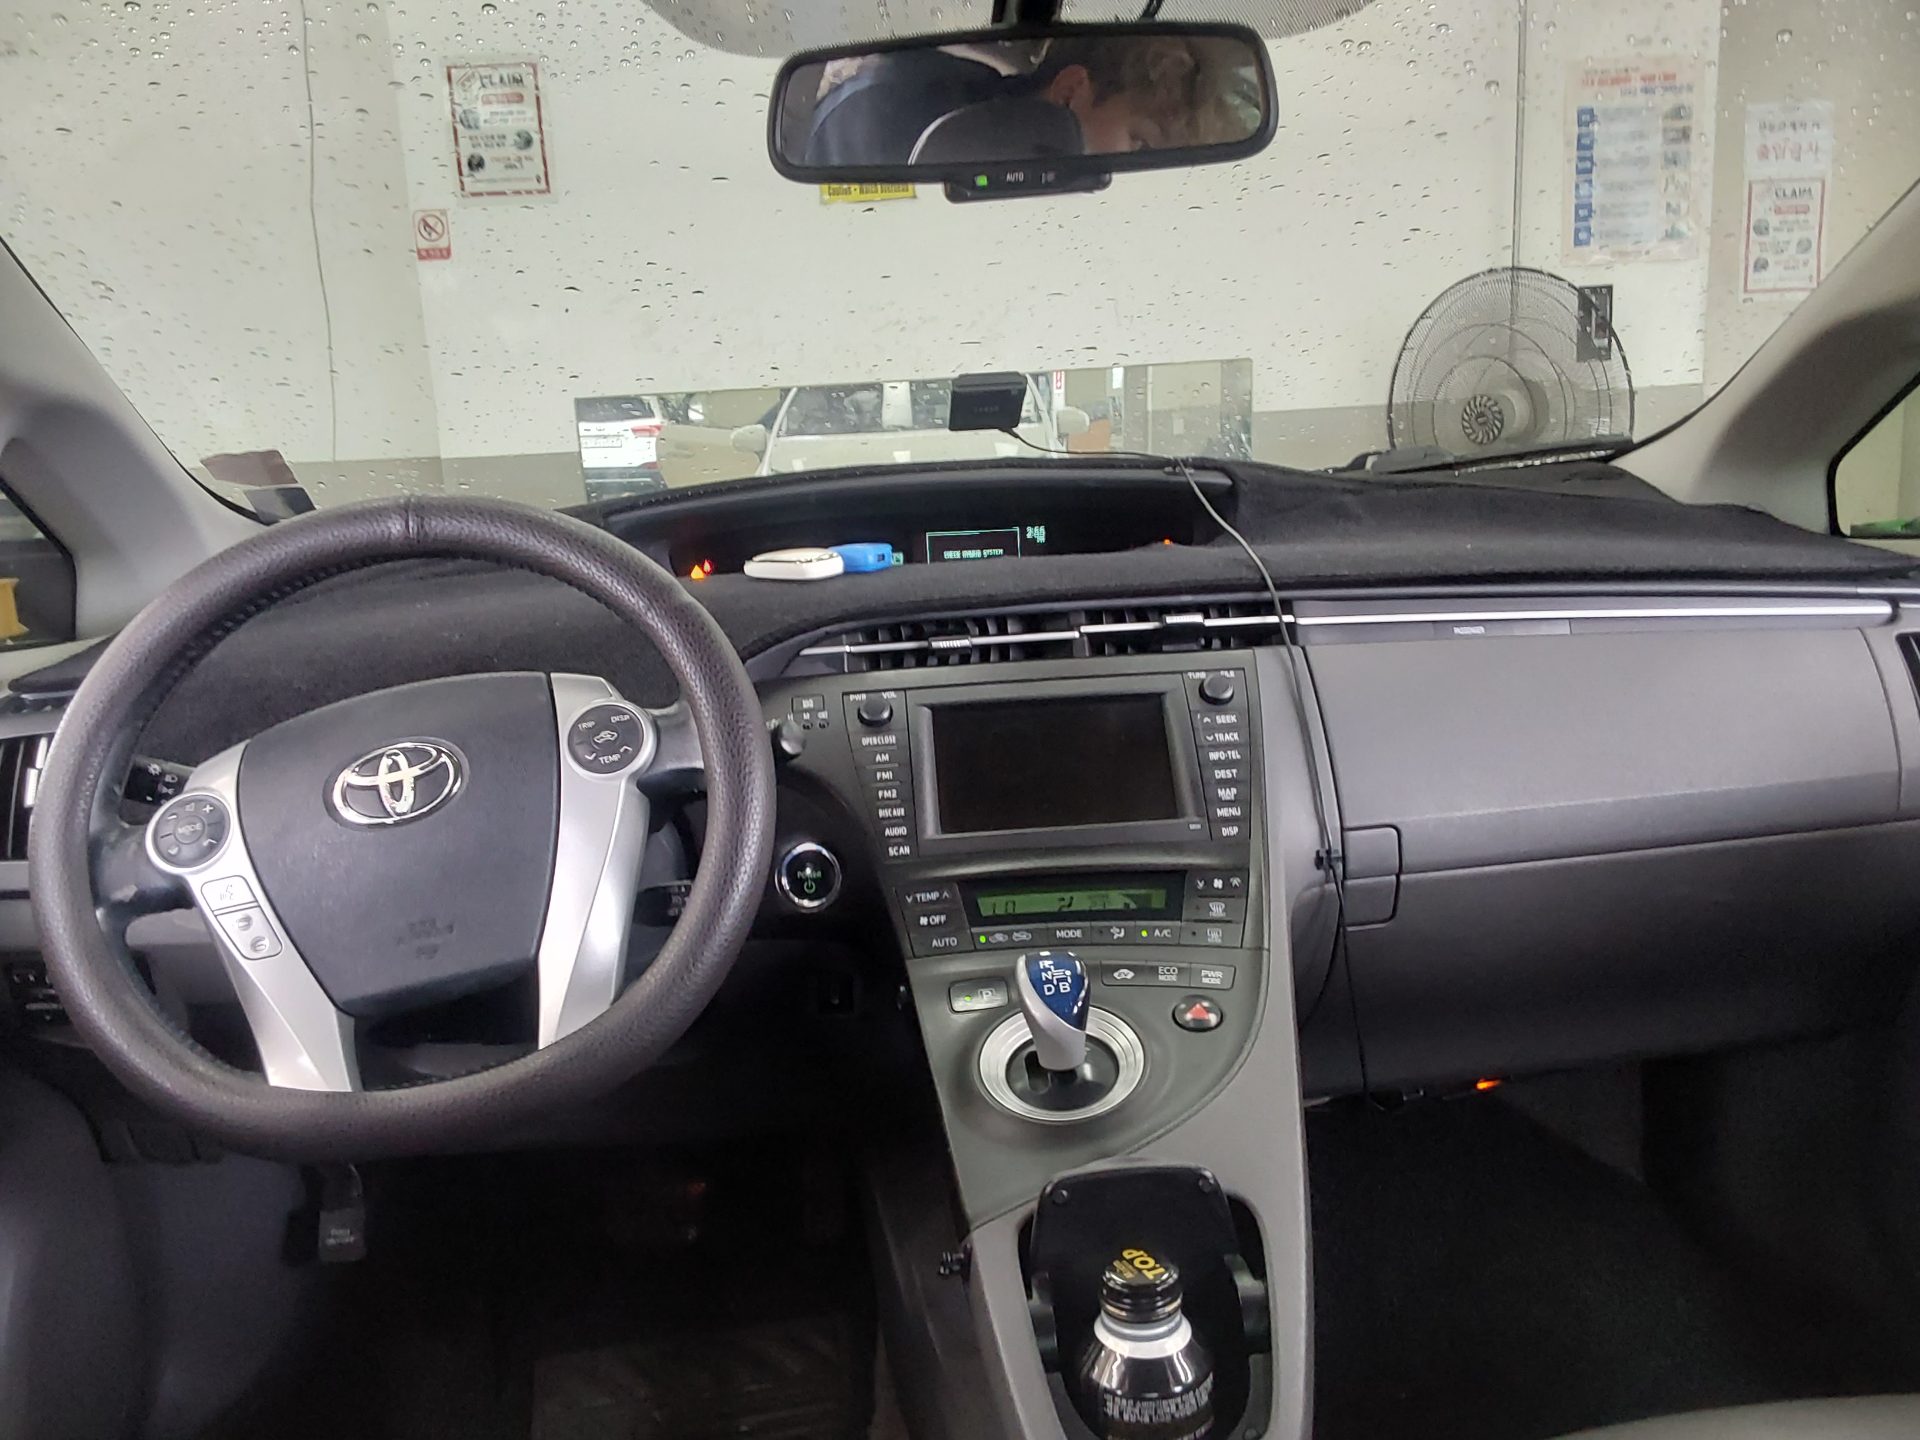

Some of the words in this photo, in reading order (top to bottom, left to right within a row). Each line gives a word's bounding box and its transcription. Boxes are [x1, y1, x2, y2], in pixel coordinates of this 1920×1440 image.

[1006, 171, 1024, 182] AUTO
[1215, 714, 1238, 724] SEEK
[1214, 731, 1240, 743] TRACK
[598, 753, 621, 765] TEMP
[875, 752, 890, 763] AM
[876, 770, 893, 781] FM1
[1214, 768, 1238, 779] DEST
[878, 788, 898, 800] FM2
[1216, 806, 1242, 818] MENU
[884, 825, 908, 838] AUDIO
[1221, 825, 1239, 837] DISP
[888, 844, 911, 857] SCAN
[915, 890, 940, 903] TEMP
[928, 914, 947, 926] OFF
[1055, 928, 1083, 939] MODE
[1153, 927, 1172, 938] A/C
[931, 936, 958, 949] AUTO
[1041, 971, 1053, 981] N
[1157, 966, 1178, 975] ECO
[1201, 969, 1223, 978] PWR
[1043, 983, 1056, 996] D
[1058, 981, 1071, 993] B
